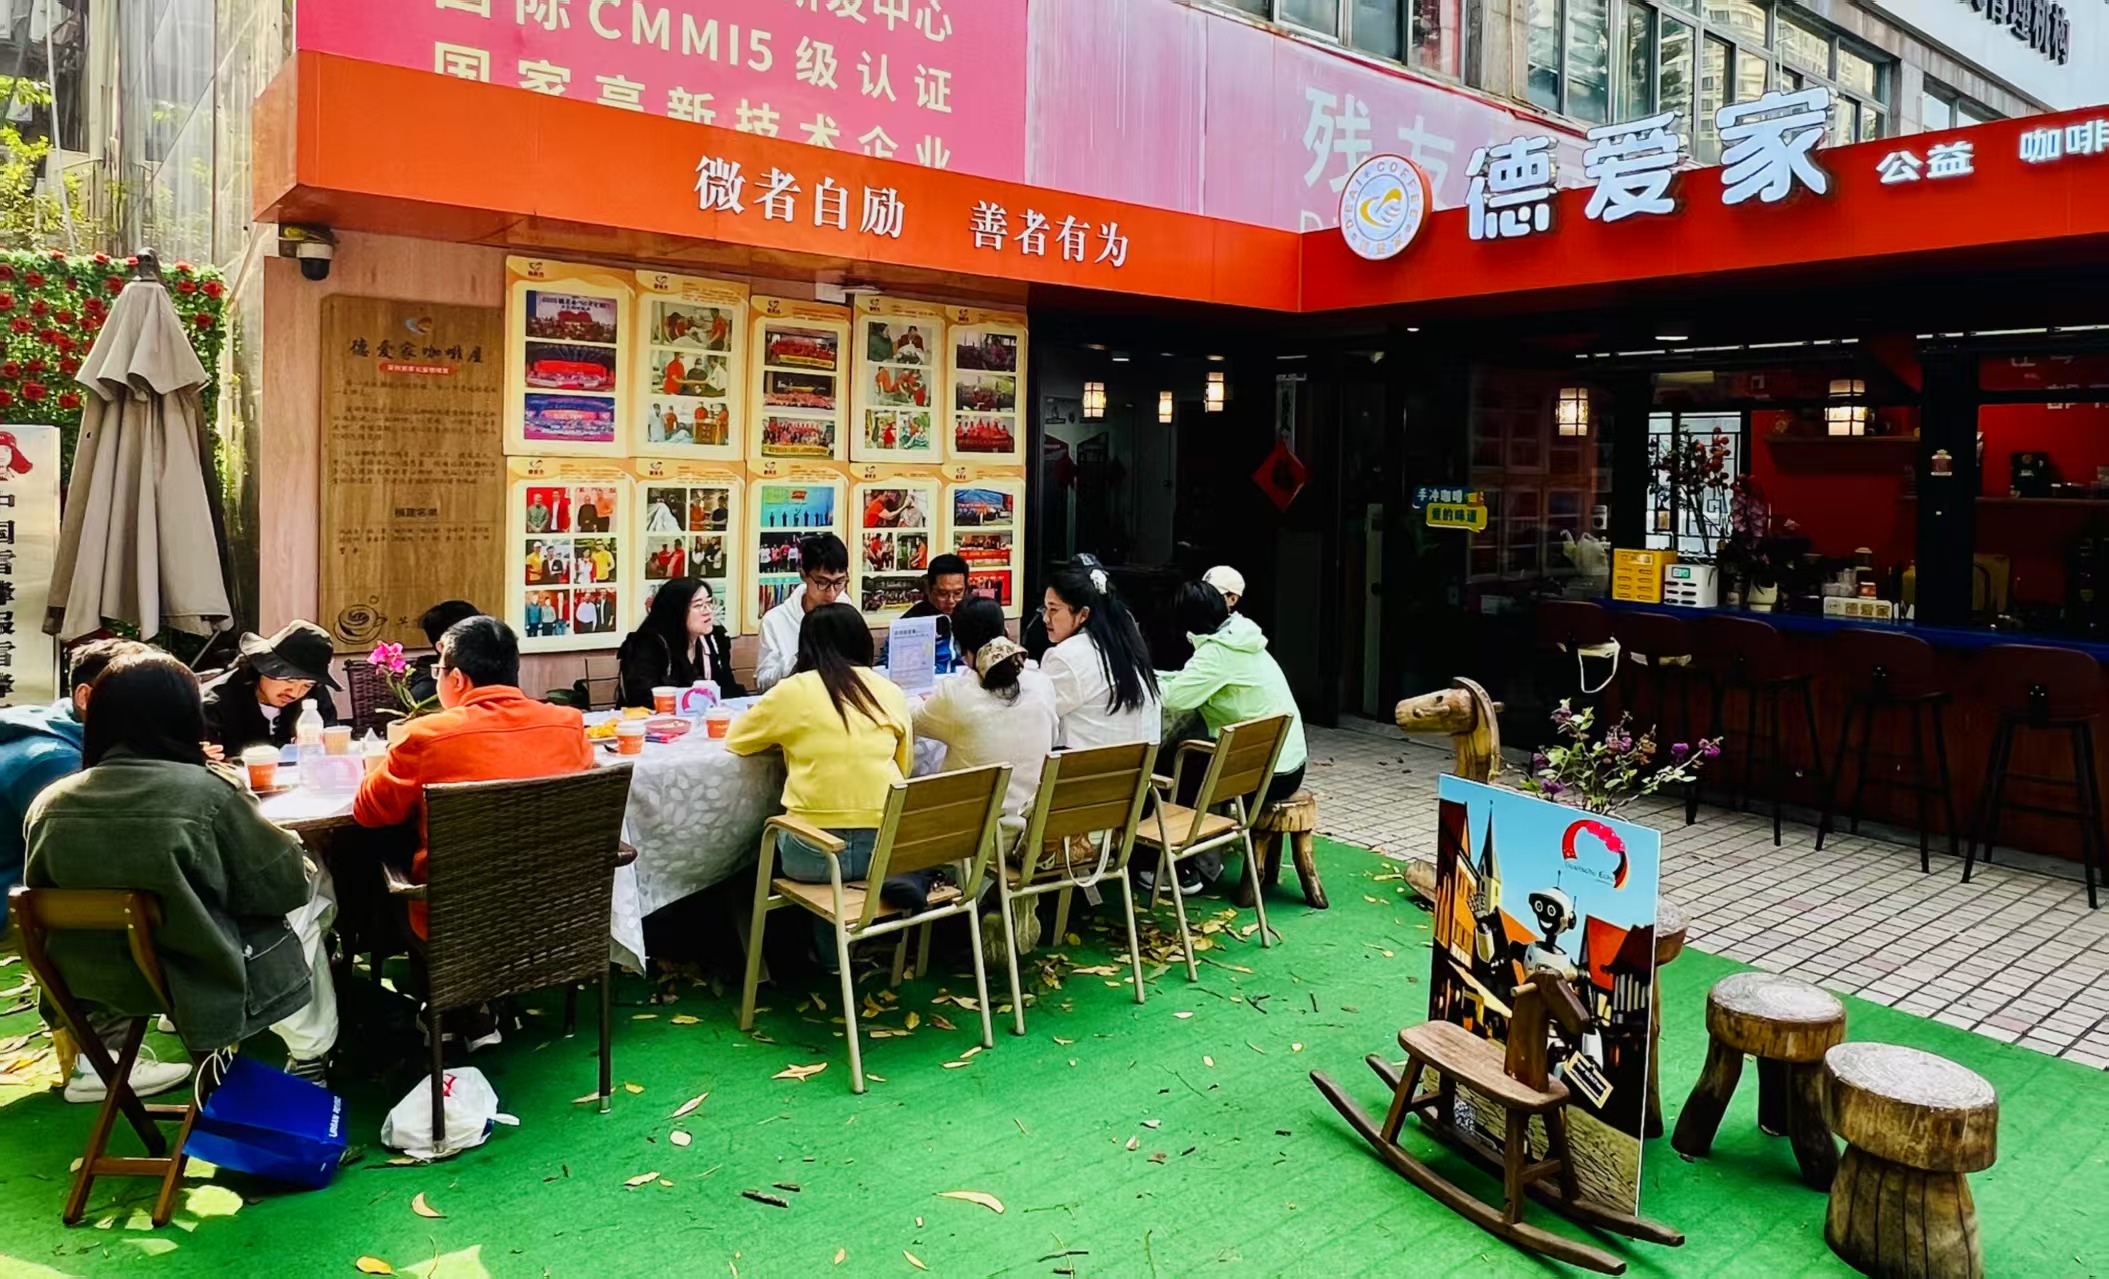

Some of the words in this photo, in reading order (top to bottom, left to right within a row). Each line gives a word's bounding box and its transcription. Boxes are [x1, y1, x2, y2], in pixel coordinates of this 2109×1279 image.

[693, 155, 905, 239] 微者自励
[970, 200, 1129, 268] 善者有为
[1465, 87, 1831, 241] 德爱家
[1876, 141, 1975, 184] 公益
